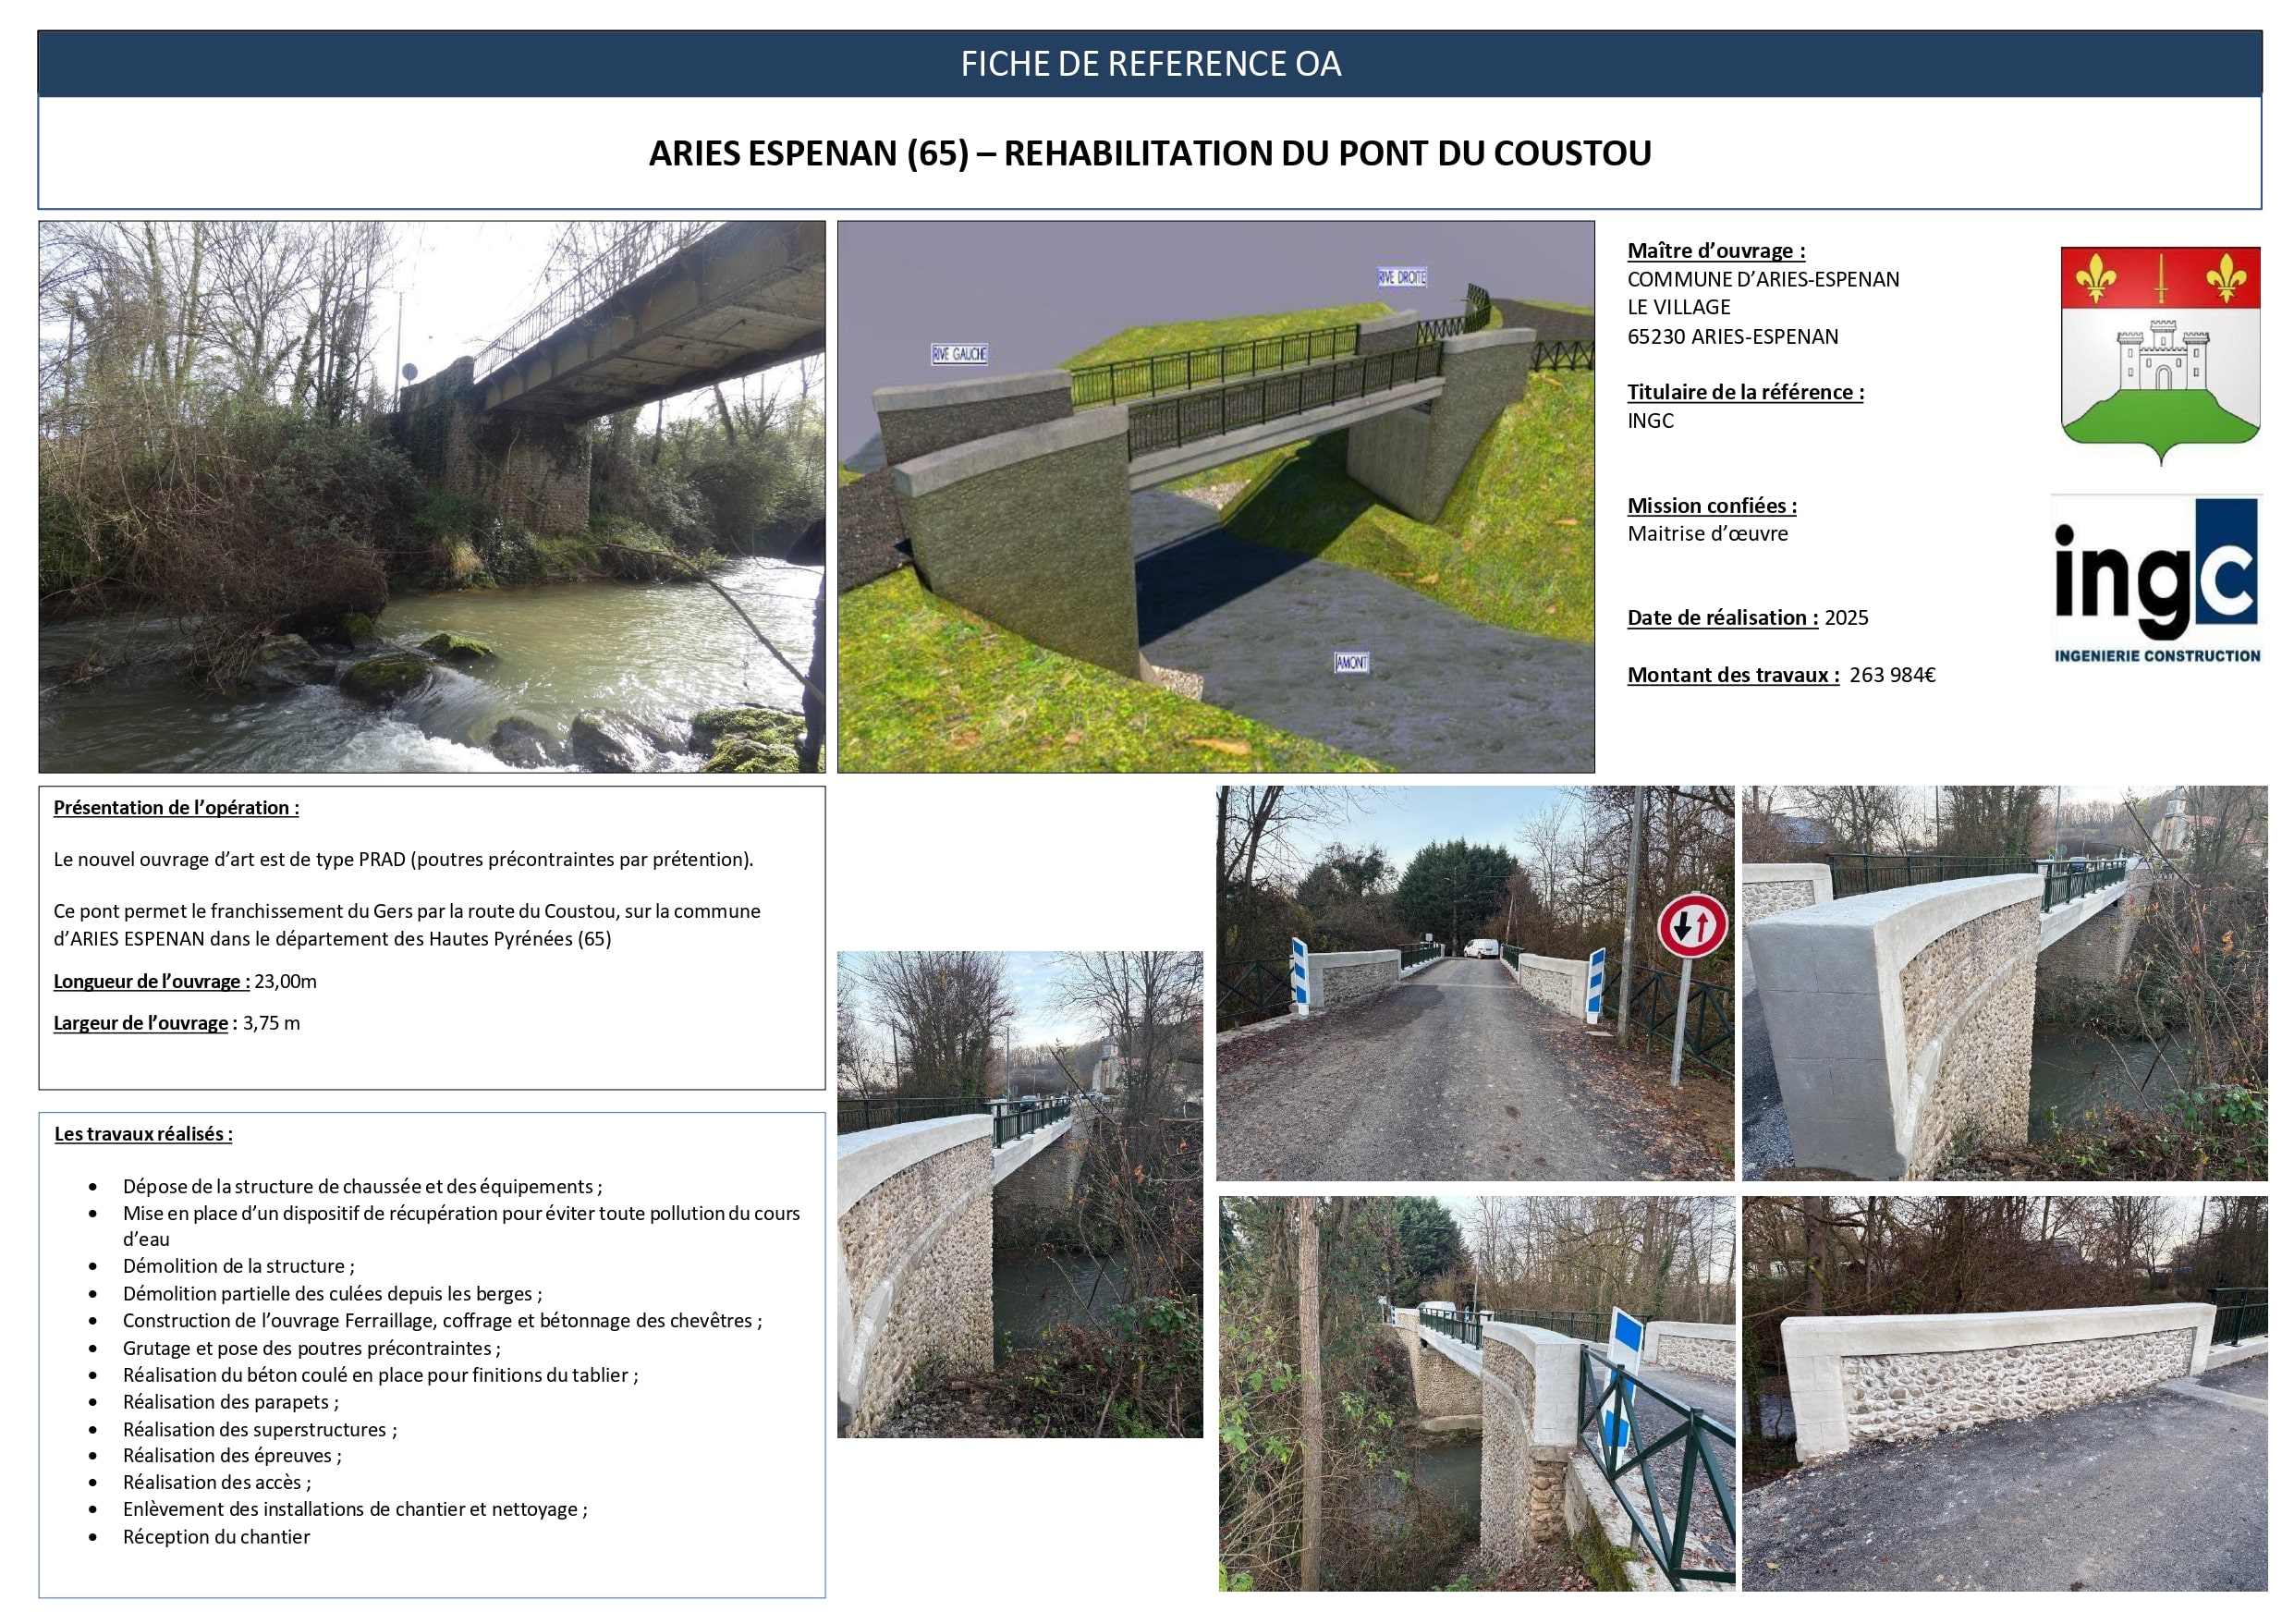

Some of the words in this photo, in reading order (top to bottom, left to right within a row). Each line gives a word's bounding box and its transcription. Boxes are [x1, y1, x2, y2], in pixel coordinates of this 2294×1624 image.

[963, 51, 1049, 76] FICHE
[1060, 51, 1098, 76] DE
[1110, 51, 1286, 76] REFERENCE
[1297, 51, 1342, 76] OA
[650, 140, 740, 165] ARIES
[750, 140, 896, 165] ESPENAN
[909, 139, 968, 172] (65)
[1007, 140, 1272, 165] REHABILITATION
[1284, 140, 1328, 165] DU
[1341, 140, 1429, 165] PONT
[1440, 140, 1484, 165] DU
[1495, 140, 1651, 165] COUSTOU
[1629, 241, 1692, 258] Maître
[1699, 242, 1793, 261] d’ouvrage
[1629, 272, 1732, 287] COMMUNE
[1739, 271, 1898, 287] D’ARIES-ESPENAN
[1629, 299, 1647, 314] LE
[1653, 299, 1730, 314] VILLAGE
[1629, 329, 1685, 344] 65230
[1691, 329, 1837, 344] ARIES-ESPENAN
[1628, 384, 1707, 399] Titulaire
[1713, 384, 1736, 399] de
[1741, 384, 1756, 399] la
[1763, 383, 1853, 399] référence
[1629, 413, 1674, 428] INGC
[1629, 497, 1701, 513] Mission
[1708, 496, 1786, 513] confiées
[1629, 526, 1704, 541] Maitrise
[1712, 525, 1788, 541] d’œuvre
[1629, 610, 1672, 625] Date
[1678, 609, 1701, 625] de
[1707, 608, 1806, 625] réalisation
[1825, 610, 1868, 625] 2025
[1337, 655, 1369, 669] AMONT
[2056, 651, 2140, 662] INGENIERIE
[2144, 650, 2260, 662] CONSTRUCTION
[1629, 667, 1712, 682] Montant
[1718, 666, 1750, 682] des
[1756, 668, 1828, 682] travaux
[1850, 667, 1884, 682] 263
[1891, 667, 1935, 682] 984€
[55, 800, 163, 814] Présentation
[169, 800, 189, 814] de
[195, 800, 288, 816] l’opération
[55, 852, 72, 866] Le
[79, 851, 134, 866] nouvel
[140, 856, 208, 870] ouvrage
[215, 851, 254, 866] d’art
[261, 853, 285, 866] est
[290, 851, 310, 866] de
[316, 853, 353, 870] type
[360, 852, 405, 866] PRAD
[411, 851, 482, 870] (poutres
[490, 850, 614, 870] précontraintes
[621, 856, 648, 870] par
[654, 850, 752, 870] prétention).
[55, 904, 74, 918] Ce
[81, 905, 119, 922] pont
[126, 905, 187, 922] permet
[193, 903, 205, 918] le
[211, 903, 343, 918] franchissement
[348, 903, 369, 918] du
[374, 904, 412, 918] Gers
[419, 908, 445, 922] par
[451, 903, 463, 918] la
[470, 905, 514, 918] route
[519, 903, 540, 918] du
[545, 904, 619, 921] Coustou,
[626, 908, 652, 918] sur
[657, 903, 669, 918] la
[675, 908, 760, 918] commune
[55, 931, 118, 946] d’ARIES
[126, 932, 203, 946] ESPENAN
[211, 931, 250, 946] dans
[257, 931, 269, 946] le
[276, 930, 388, 949] département
[395, 931, 423, 946] des
[431, 932, 488, 946] Hautes
[495, 930, 572, 949] Pyrénées
[579, 931, 611, 949] (65)
[55, 974, 133, 990] Longueur
[138, 973, 158, 988] de
[163, 973, 240, 990] l’ouvrage
[255, 974, 316, 990] 23,00m
[55, 1015, 118, 1032] Largeur
[123, 1015, 143, 1030] de
[149, 1015, 228, 1032] l’ouvrage
[244, 1016, 278, 1032] 3,75
[286, 1020, 299, 1030] m
[55, 1127, 83, 1141] Les
[87, 1128, 153, 1141] travaux
[158, 1126, 224, 1141] réalisés
[125, 1178, 187, 1197] Dépose
[192, 1178, 212, 1193] de
[218, 1178, 230, 1193] la
[236, 1180, 312, 1193] structure
[319, 1178, 338, 1193] de
[344, 1178, 421, 1193] chaussée
[426, 1180, 443, 1193] et
[447, 1178, 476, 1193] des
[481, 1178, 592, 1197] équipements
[125, 1206, 163, 1220] Mise
[168, 1210, 189, 1220] en
[194, 1205, 237, 1224] place
[242, 1205, 278, 1220] d’un
[284, 1205, 360, 1224] dispositif
[364, 1205, 384, 1220] de
[391, 1204, 497, 1224] récupération
[504, 1210, 543, 1224] pour
[546, 1204, 595, 1220] éviter
[599, 1207, 644, 1220] toute
[652, 1205, 725, 1224] pollution
[729, 1205, 750, 1220] du
[755, 1210, 799, 1220] cours
[124, 1231, 169, 1246] d’eau
[124, 1313, 230, 1327] Construction
[236, 1313, 255, 1327] de
[263, 1313, 338, 1331] l’ouvrage
[347, 1313, 436, 1331] Ferraillage,
[444, 1313, 511, 1331] coffrage
[519, 1314, 534, 1327] et
[542, 1312, 629, 1331] bétonnage
[637, 1313, 665, 1327] des
[671, 1312, 751, 1327] chevêtres
[124, 1341, 189, 1359] Grutage
[197, 1342, 213, 1355] et
[219, 1345, 257, 1359] pose
[263, 1340, 291, 1355] des
[299, 1342, 361, 1359] poutres
[369, 1339, 491, 1359] précontraintes
[125, 1366, 216, 1382] Réalisation
[222, 1367, 242, 1382] du
[249, 1366, 297, 1382] béton
[302, 1366, 347, 1382] coulé
[353, 1372, 372, 1382] en
[380, 1367, 422, 1386] place
[429, 1372, 469, 1386] pour
[472, 1367, 542, 1382] finitions
[547, 1367, 567, 1382] du
[572, 1367, 628, 1382] tablier
[125, 1500, 224, 1516] Enlèvement
[230, 1501, 258, 1516] des
[264, 1501, 363, 1516] installations
[371, 1501, 389, 1516] de
[397, 1501, 466, 1516] chantier
[470, 1503, 486, 1516] et
[494, 1503, 577, 1520] nettoyage
